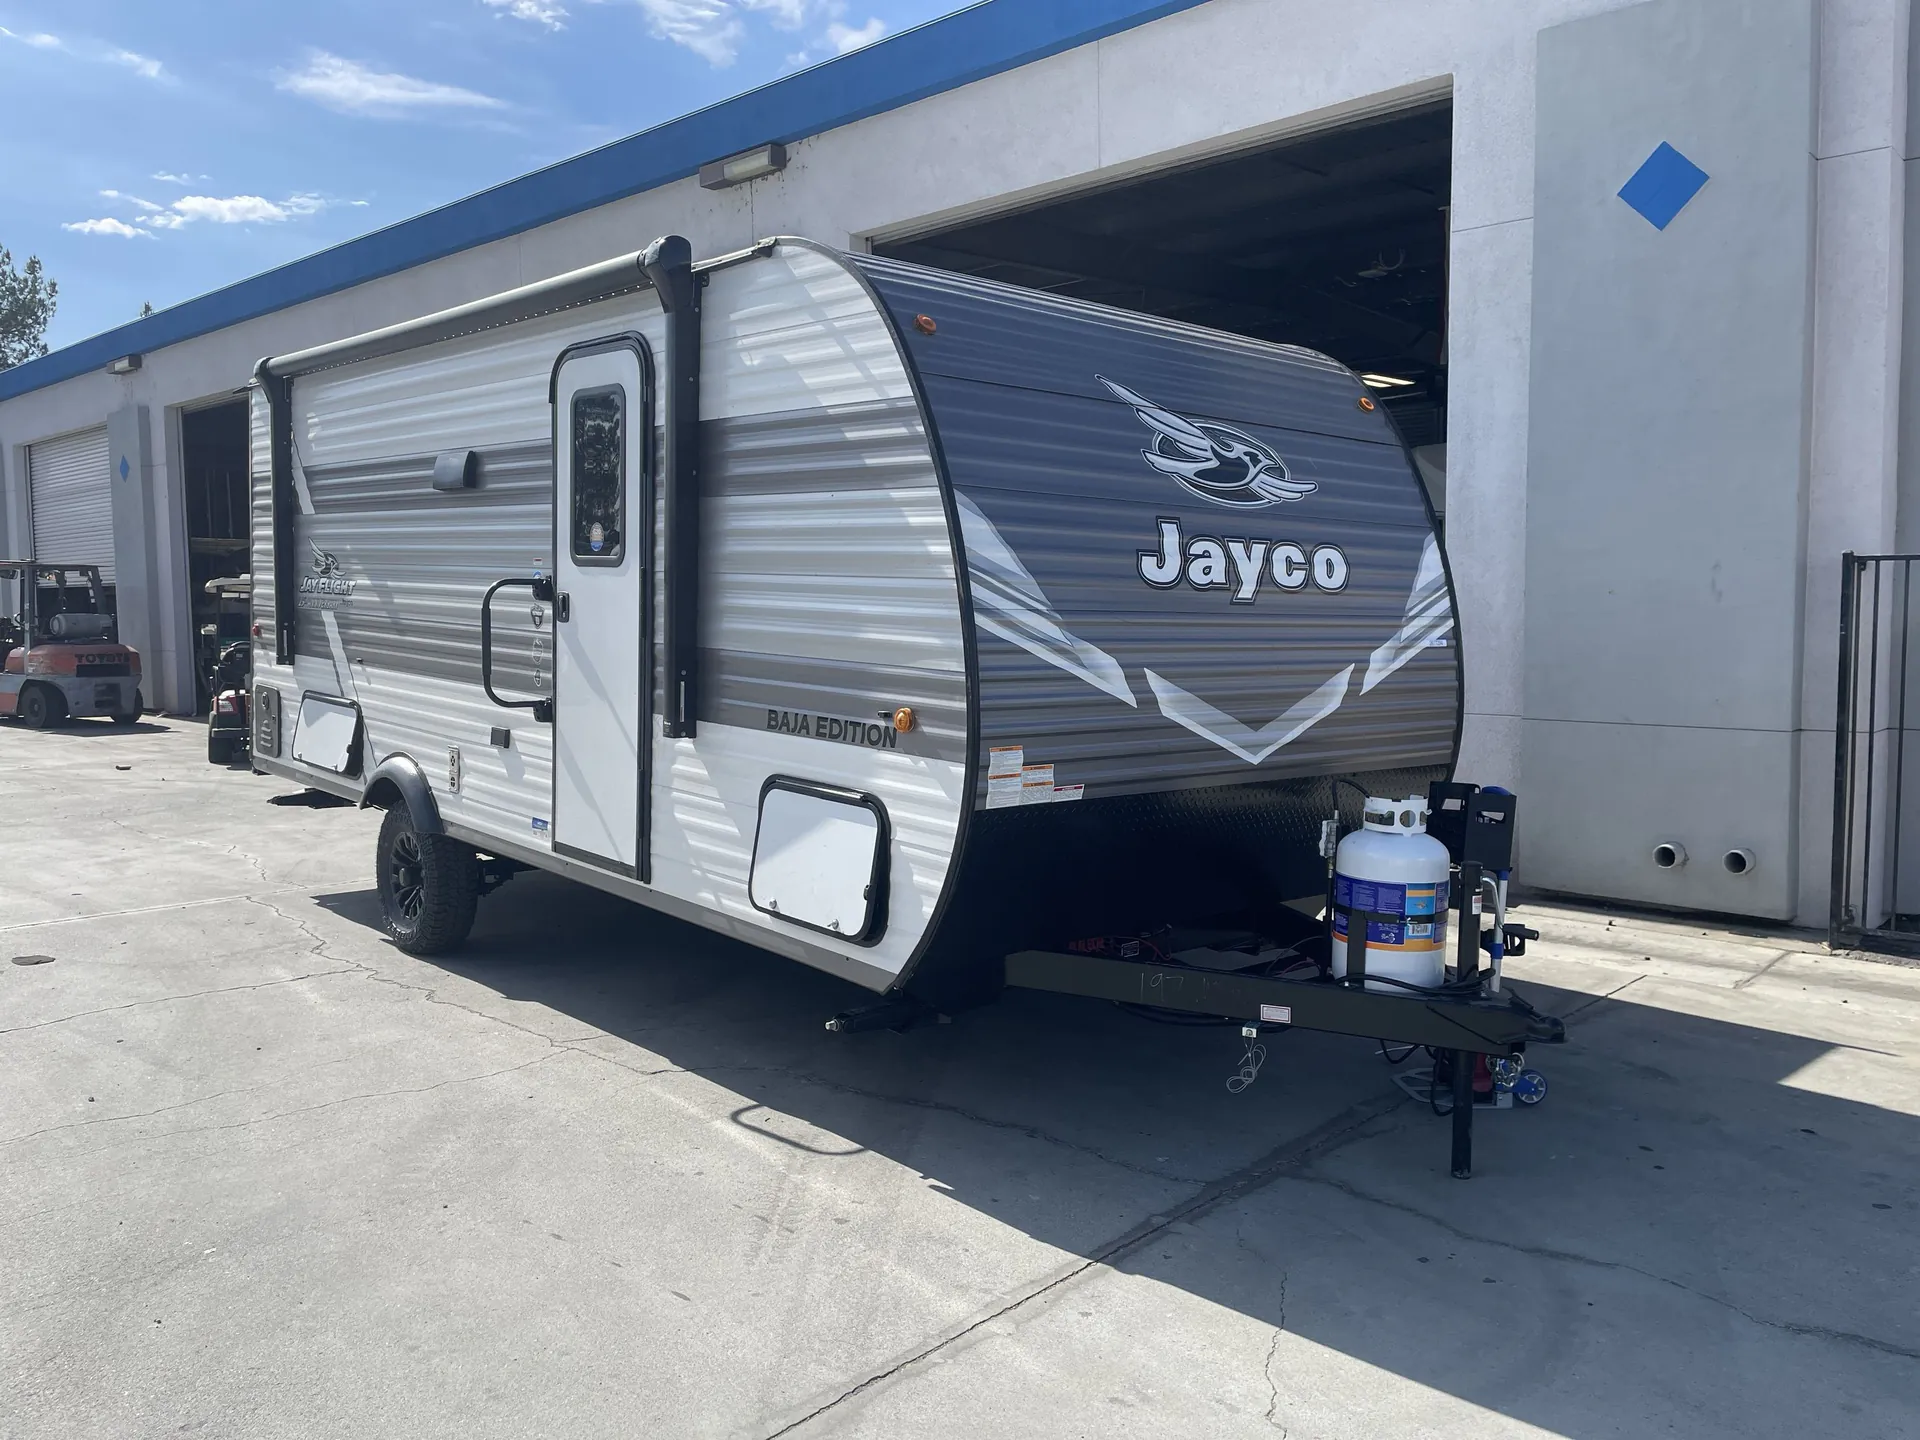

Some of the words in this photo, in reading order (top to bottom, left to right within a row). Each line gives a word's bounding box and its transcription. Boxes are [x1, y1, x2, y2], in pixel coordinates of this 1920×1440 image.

[1137, 516, 1349, 605] Jayco
[300, 576, 318, 593] JAY
[317, 577, 356, 595] FLIGHT
[75, 653, 131, 664] TOYOTA
[766, 709, 810, 735] BAJA
[815, 716, 897, 749] EDITION
